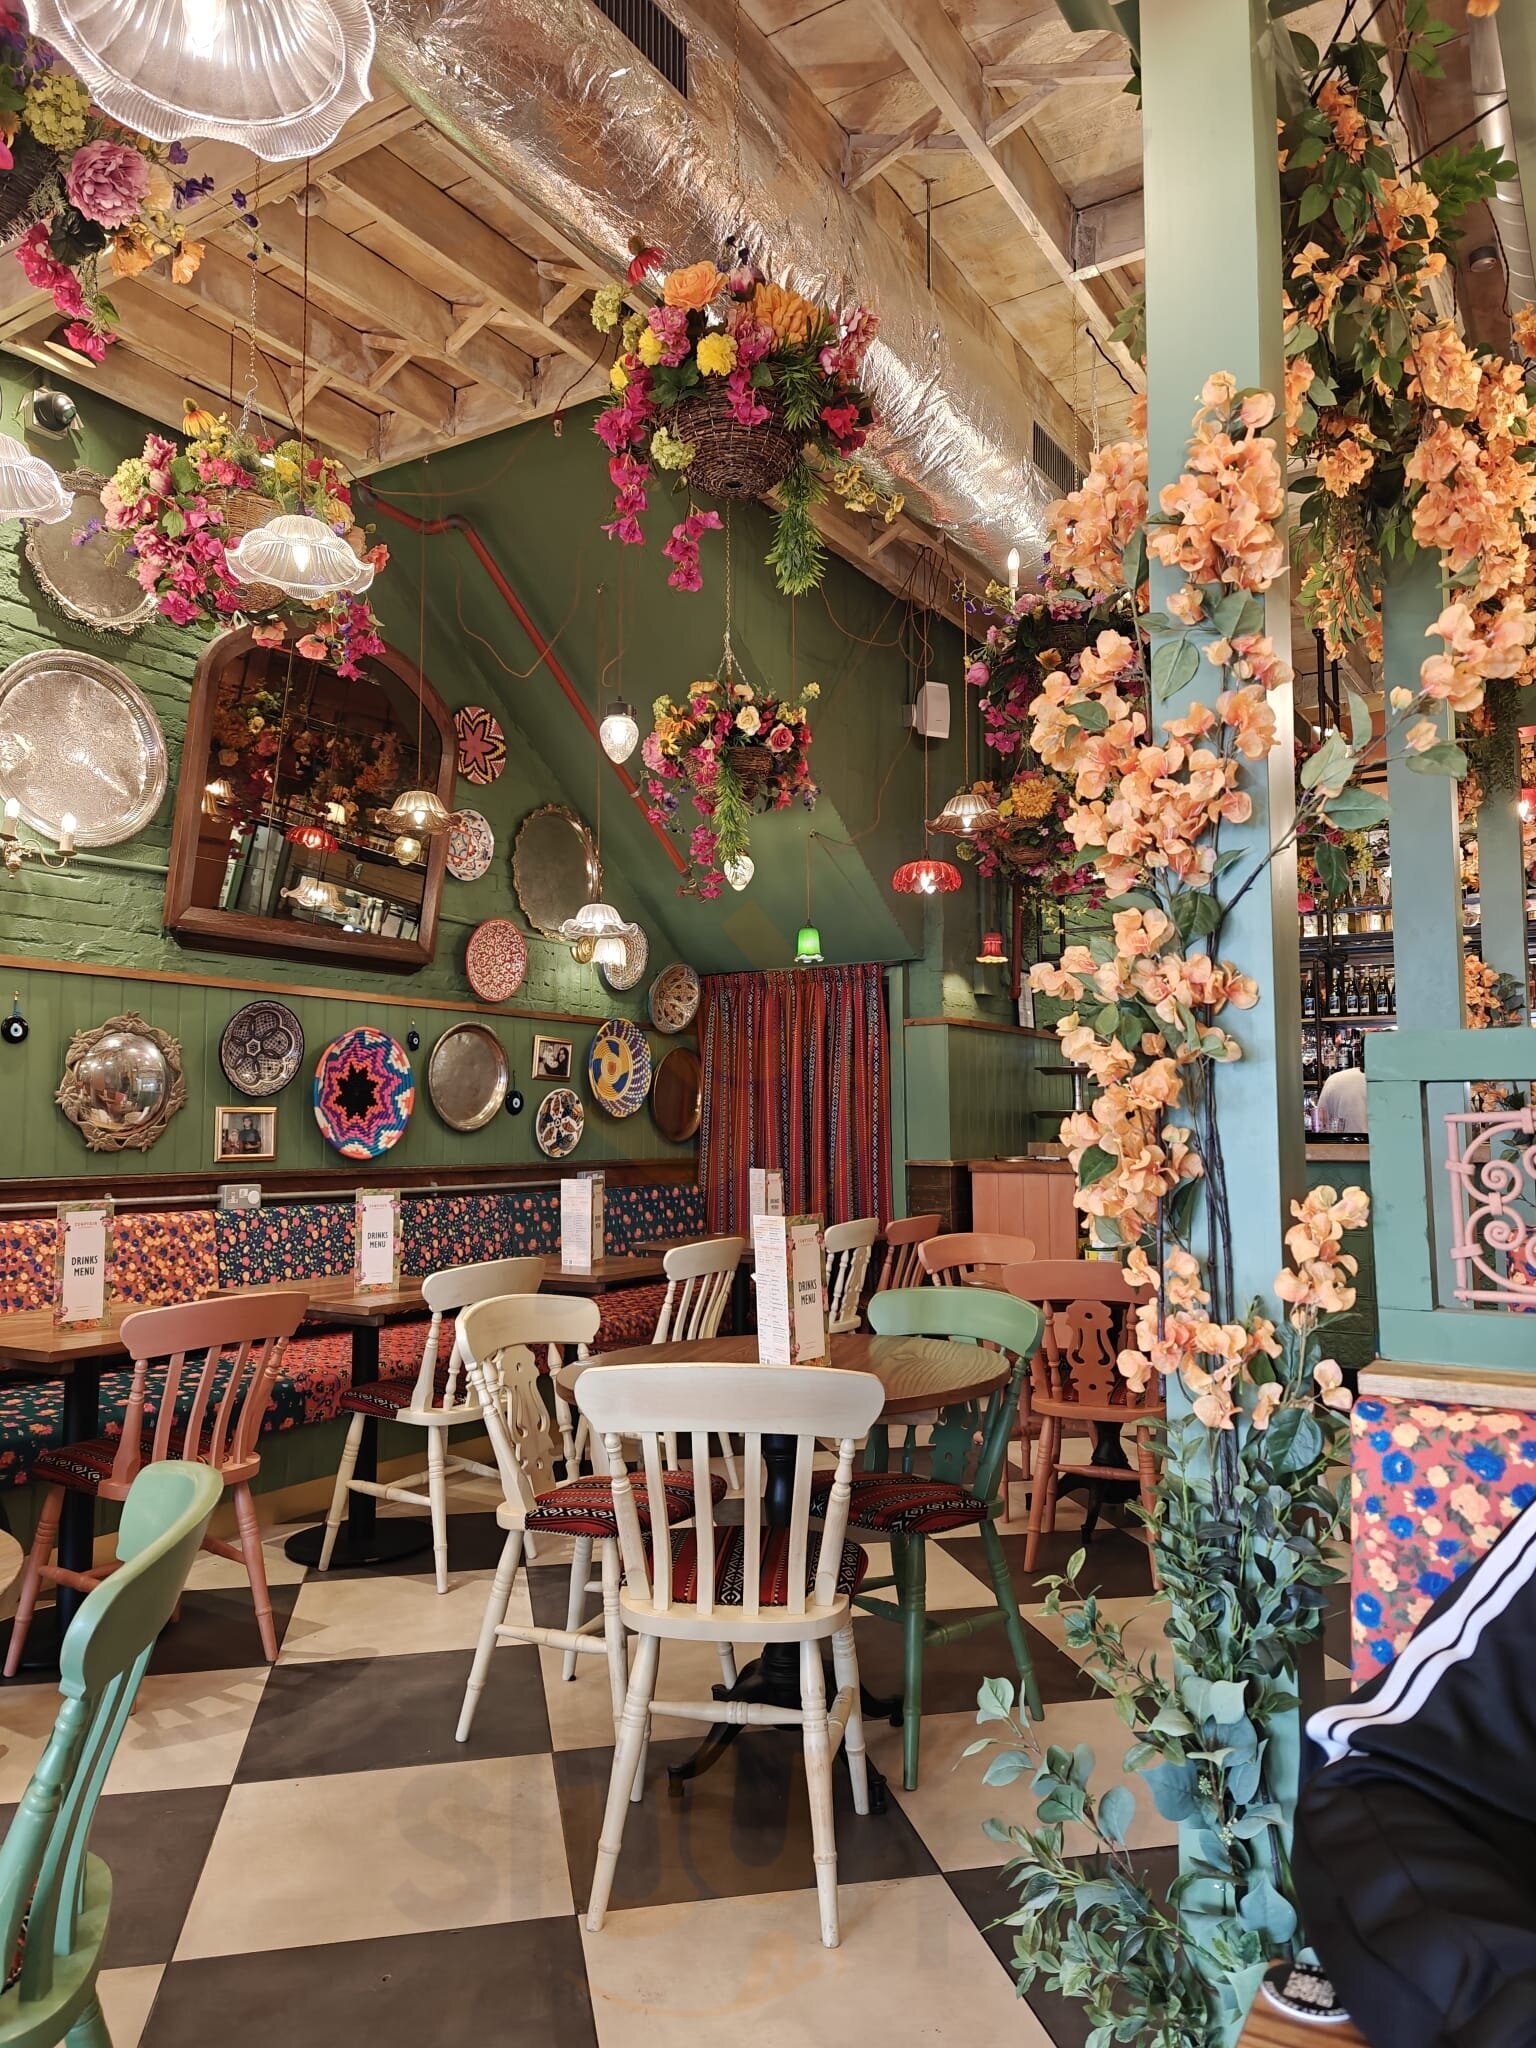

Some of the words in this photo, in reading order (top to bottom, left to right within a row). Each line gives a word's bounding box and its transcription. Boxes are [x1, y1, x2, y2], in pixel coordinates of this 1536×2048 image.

[367, 1231, 389, 1240] DRINKS
[369, 1240, 386, 1249] MENU
[71, 1255, 98, 1266] DRINKS
[73, 1266, 95, 1277] MENU
[798, 1278, 817, 1292] DRINKS
[800, 1292, 816, 1305] MENU
